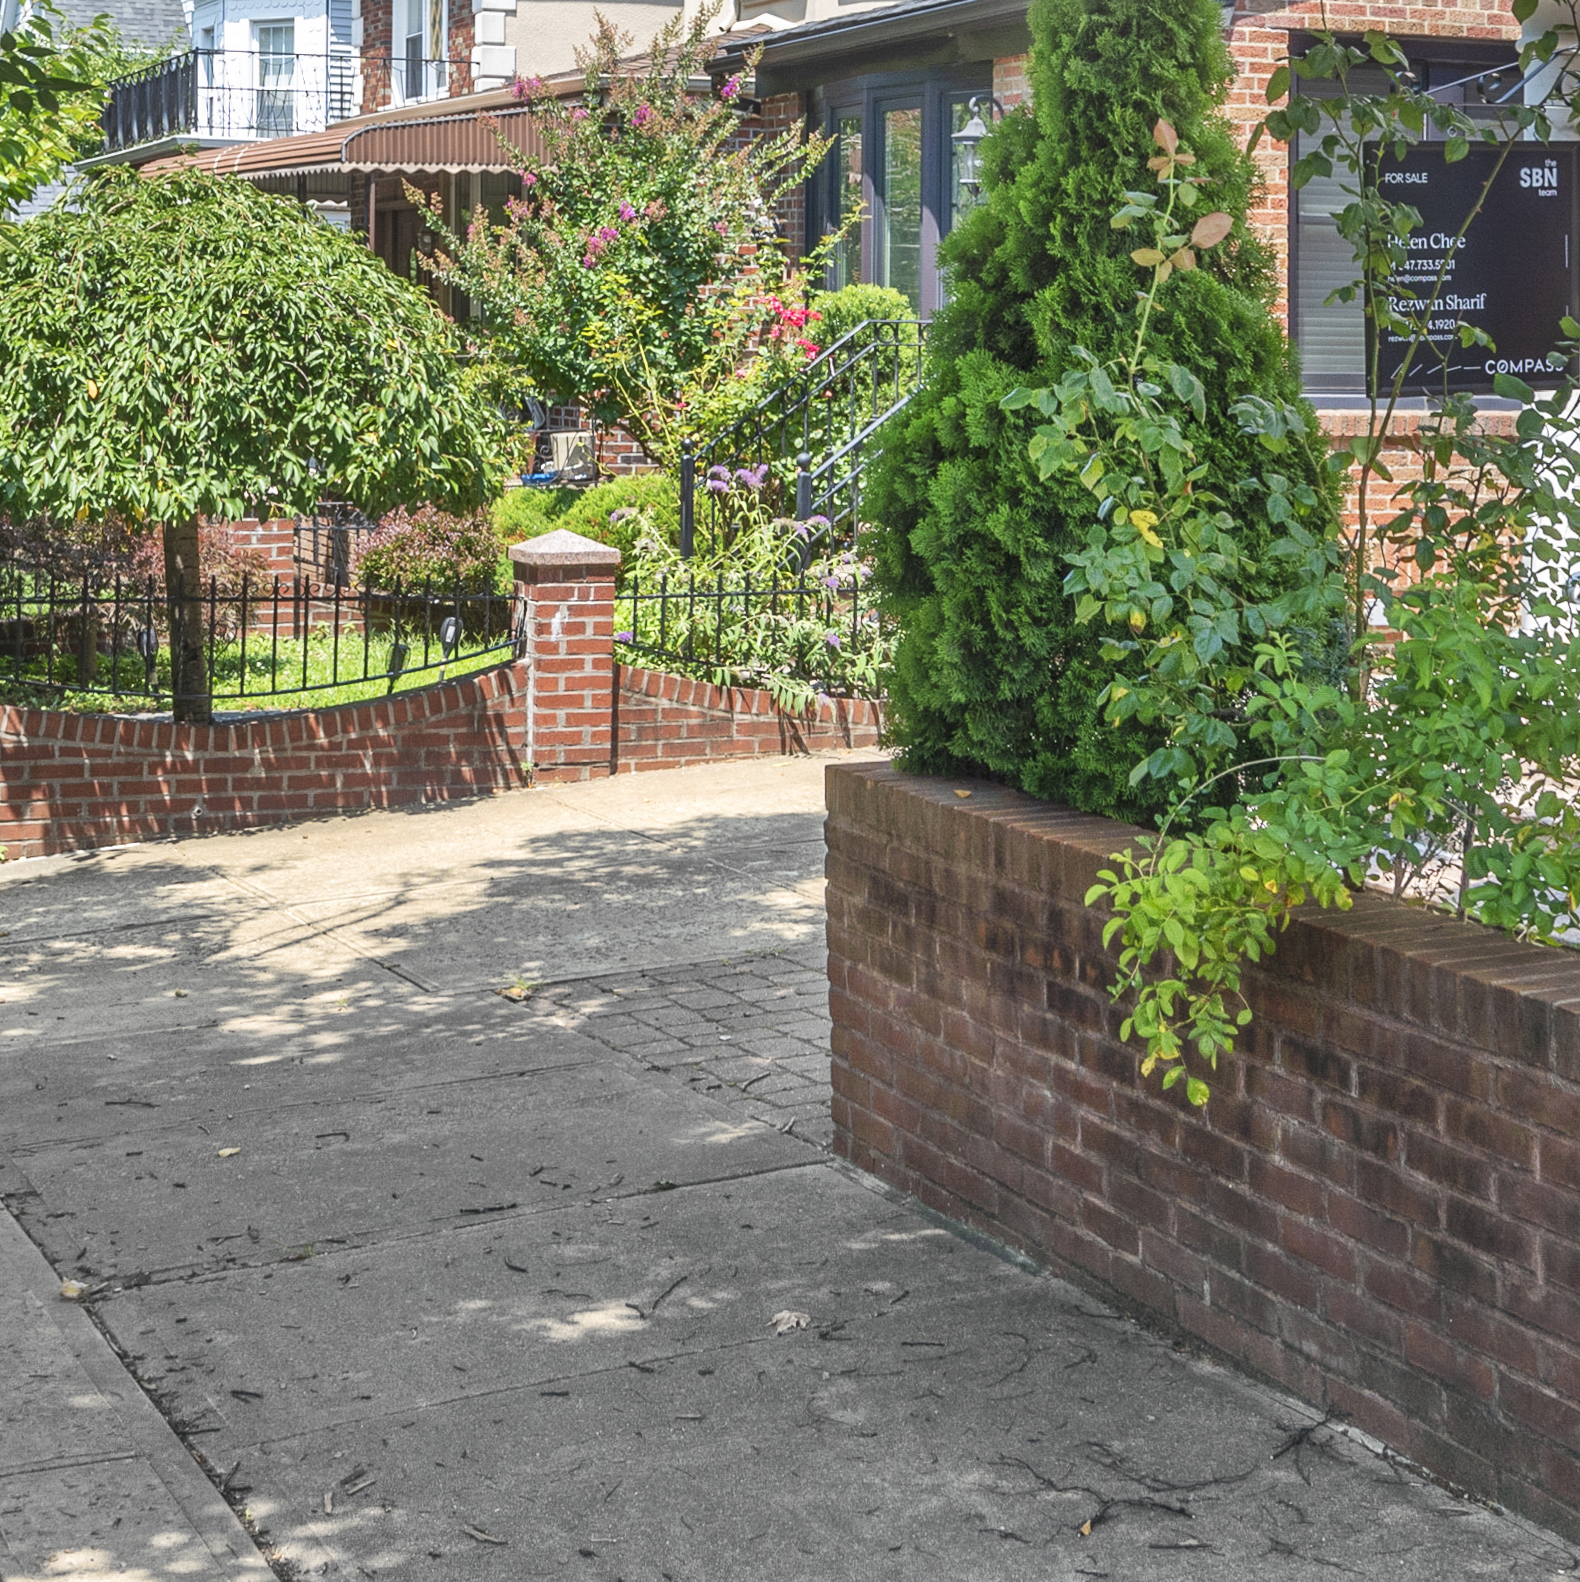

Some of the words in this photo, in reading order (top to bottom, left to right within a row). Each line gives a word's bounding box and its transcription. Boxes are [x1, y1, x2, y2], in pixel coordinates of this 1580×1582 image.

[1545, 158, 1557, 167] the
[1384, 172, 1404, 184] FOR
[1405, 172, 1428, 184] SALE
[1520, 167, 1557, 187] SBN
[1538, 189, 1557, 197] team
[1445, 293, 1487, 310] Sharif
